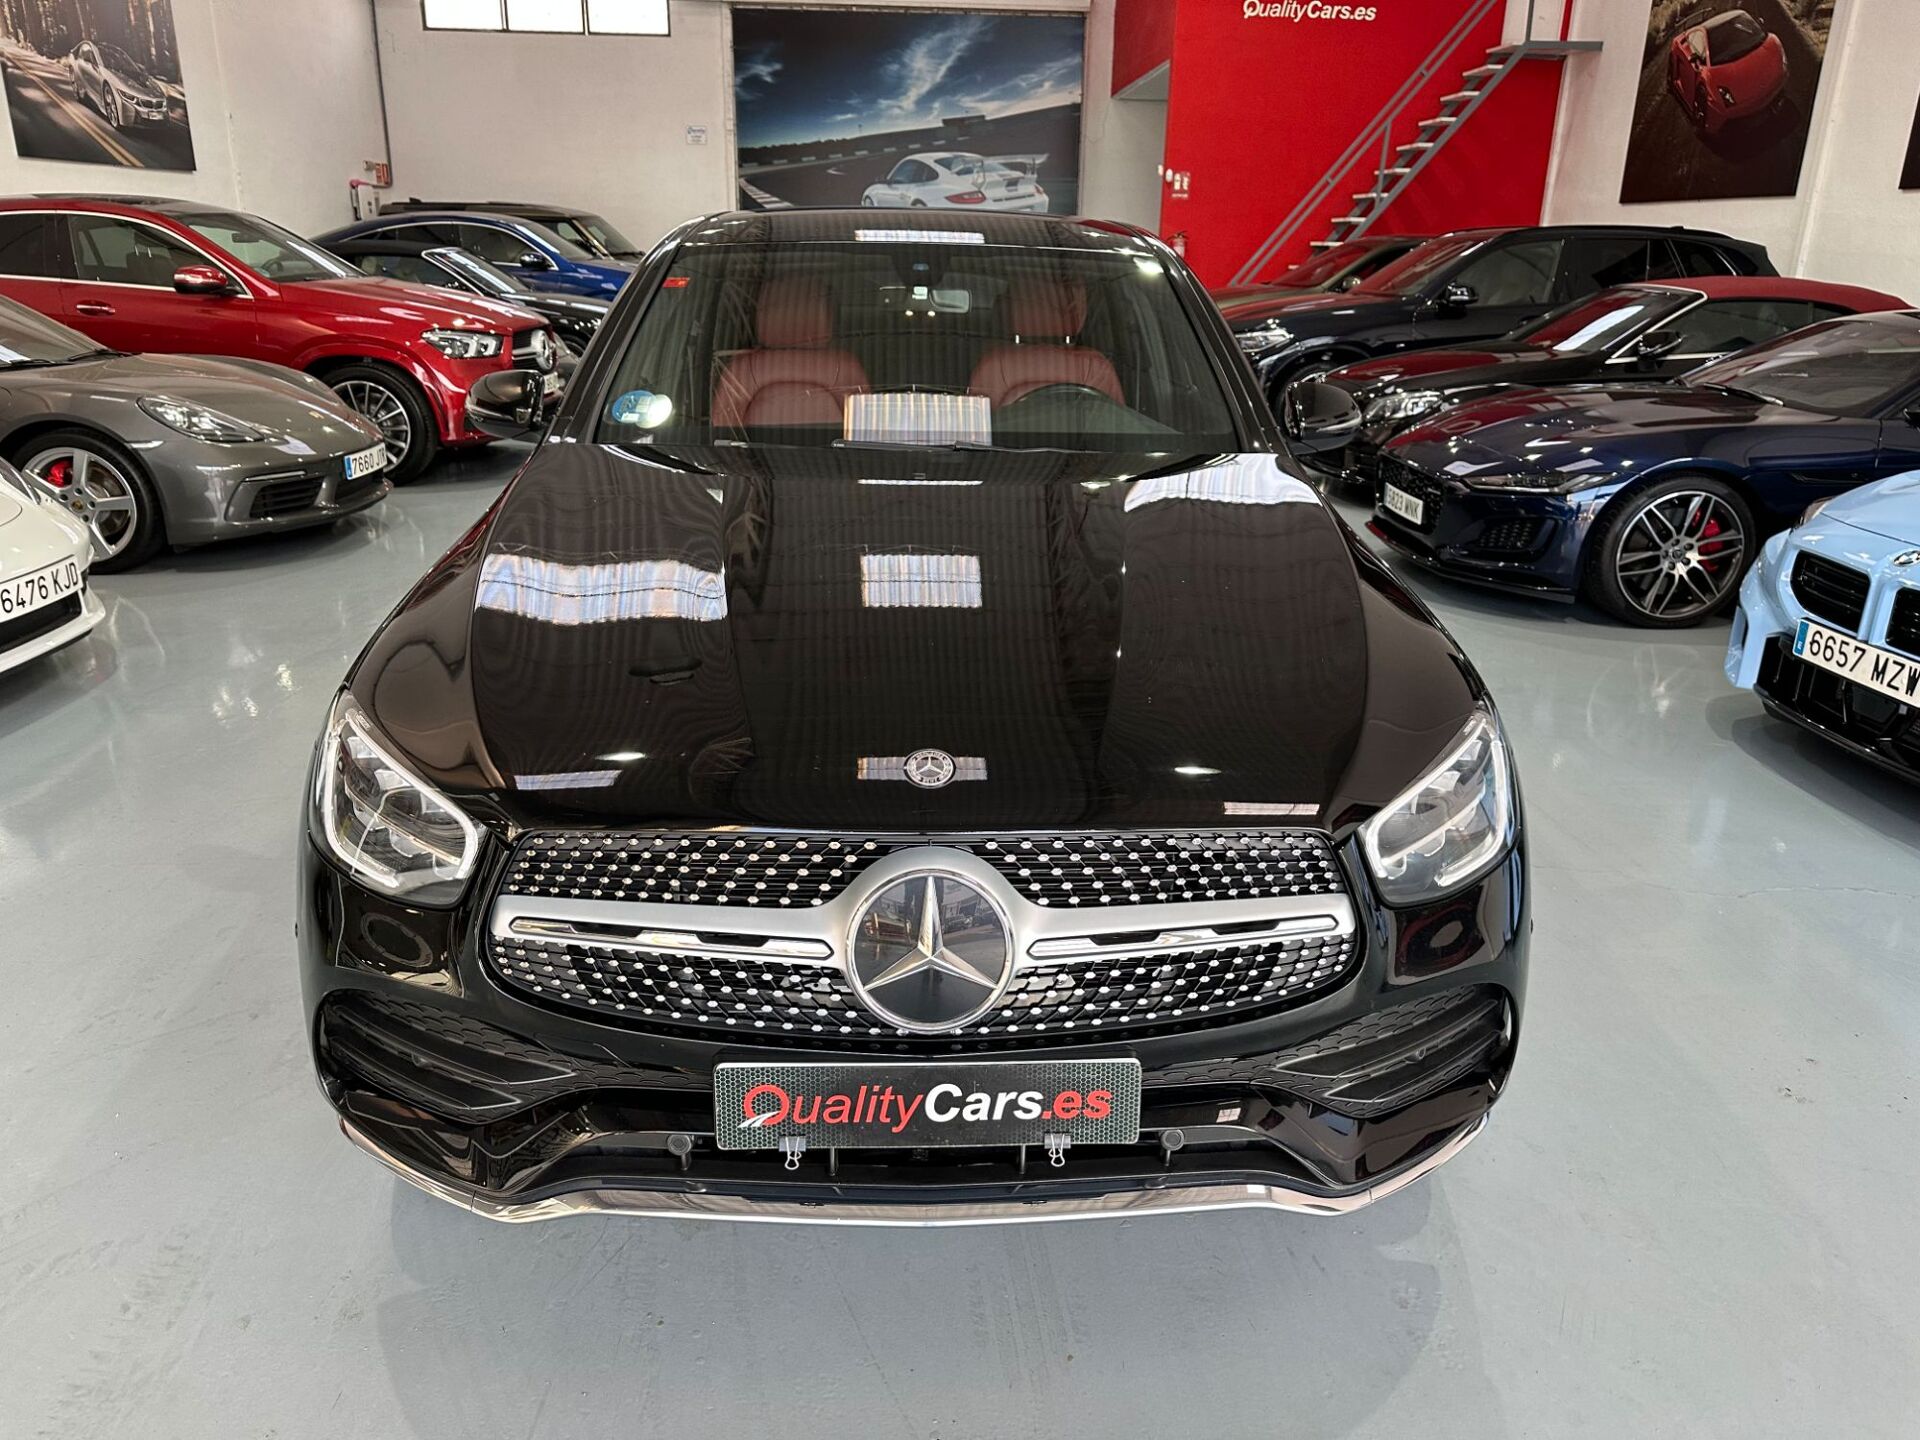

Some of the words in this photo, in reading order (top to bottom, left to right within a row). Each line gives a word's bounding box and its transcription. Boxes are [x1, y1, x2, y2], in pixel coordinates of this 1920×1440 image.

[1243, 0, 1377, 22] QualityCars.es
[352, 453, 374, 475] 7660
[1, 576, 48, 613] 6476
[51, 562, 79, 595] KJD
[1809, 630, 1866, 672] 6657
[1871, 653, 1920, 697] MZW
[737, 1083, 1113, 1133] QualityCars.es
